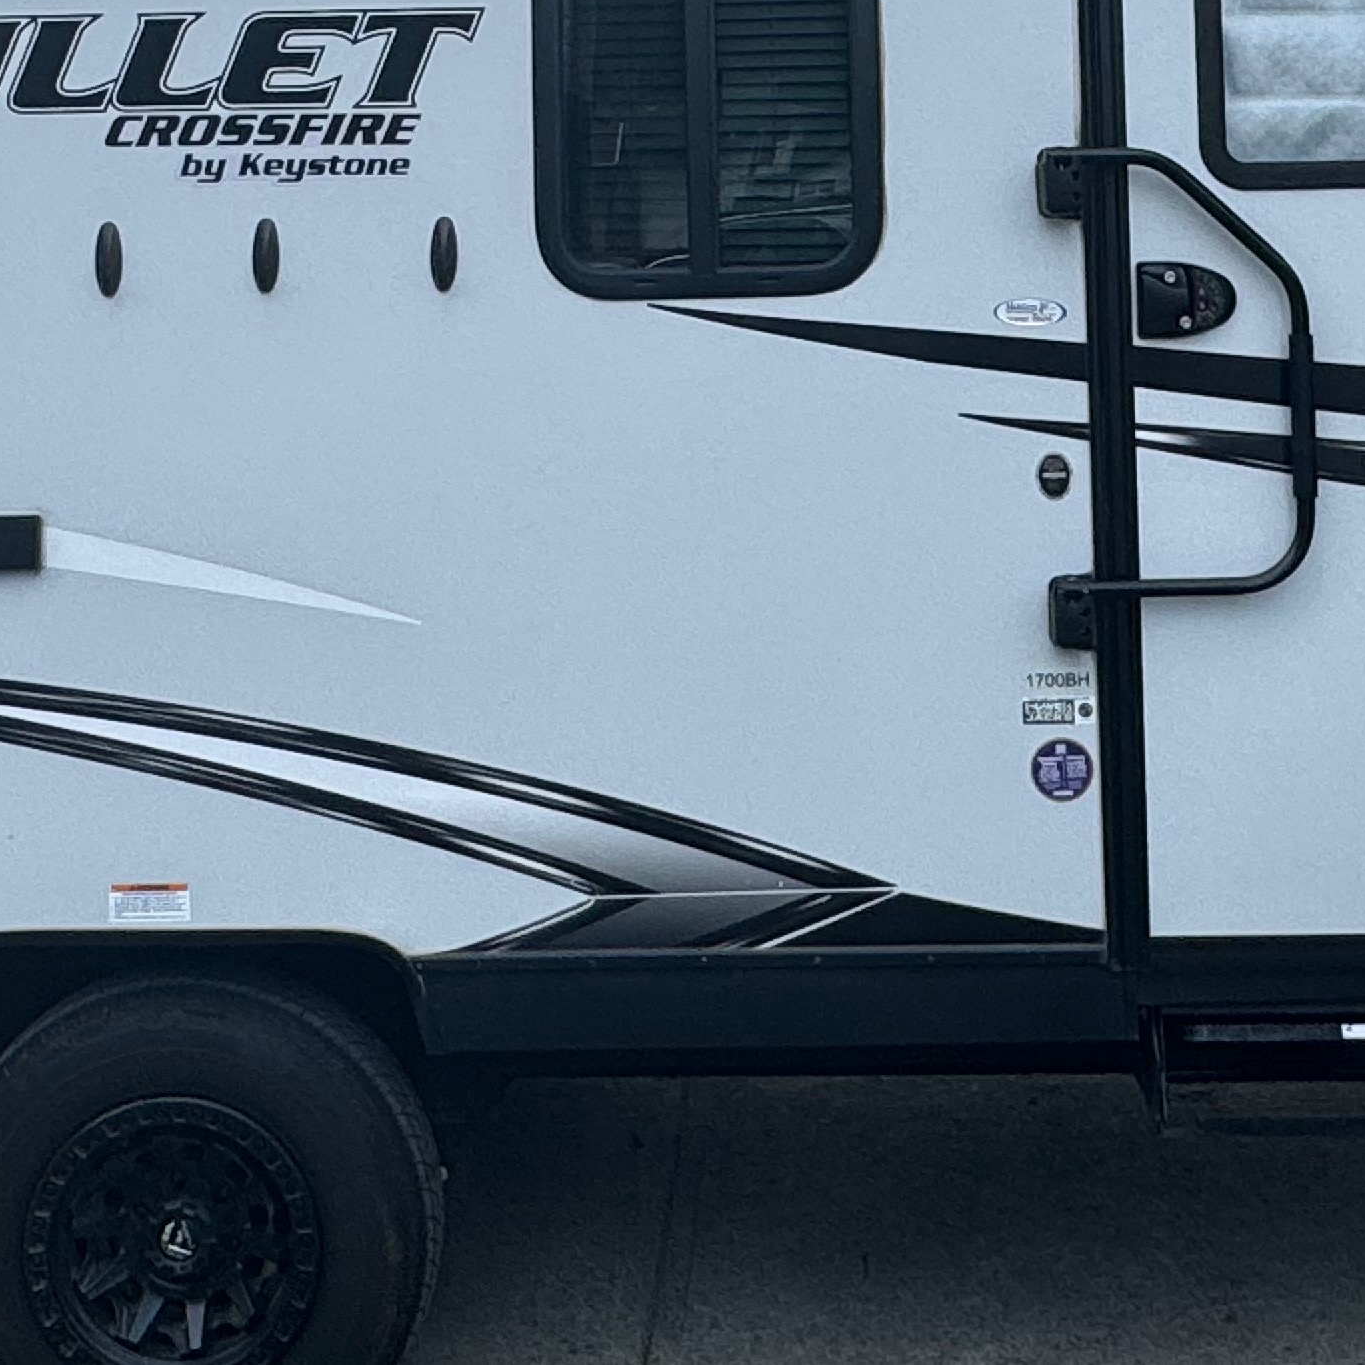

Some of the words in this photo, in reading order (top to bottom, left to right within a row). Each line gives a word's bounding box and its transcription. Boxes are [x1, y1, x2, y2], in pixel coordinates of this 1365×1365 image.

[105, 113, 422, 147] CROSSFIRE
[180, 153, 227, 183] by
[239, 152, 411, 183] Keystone
[1026, 672, 1090, 688] 1700BH
